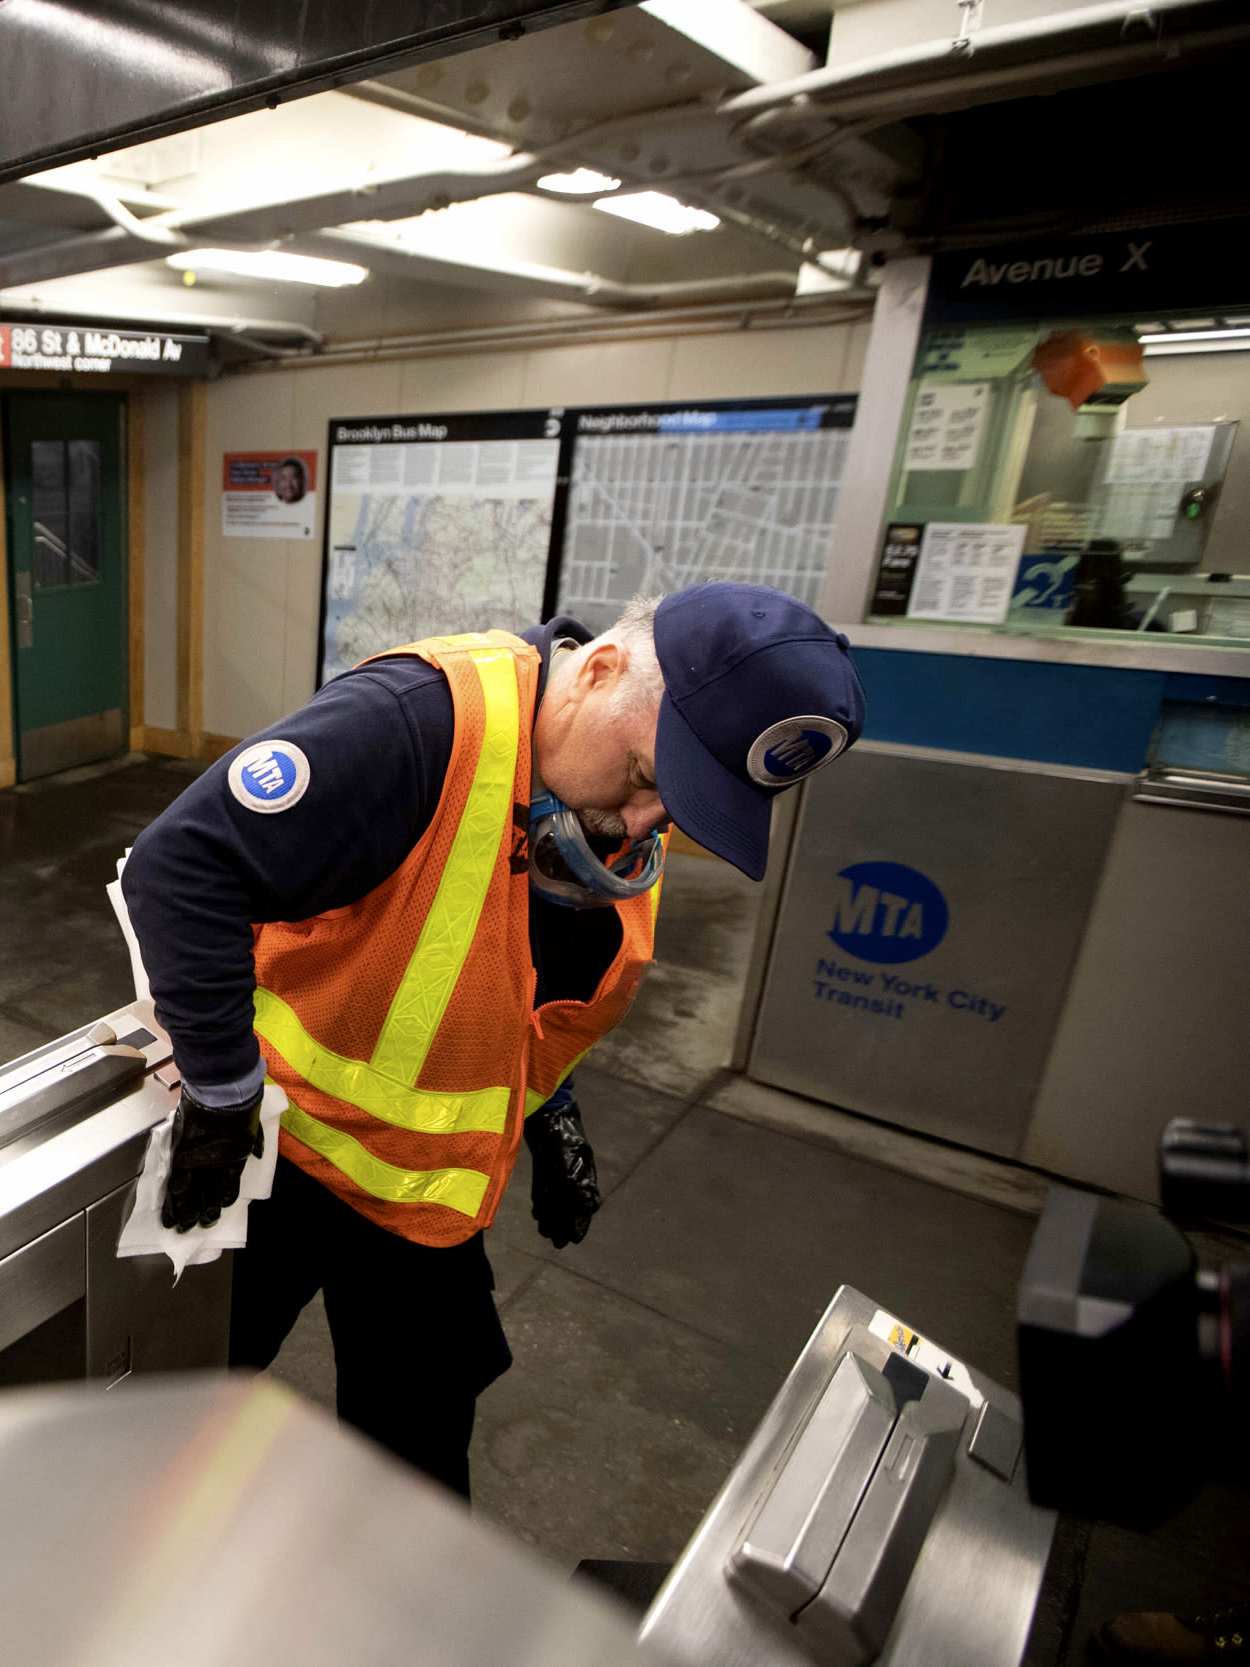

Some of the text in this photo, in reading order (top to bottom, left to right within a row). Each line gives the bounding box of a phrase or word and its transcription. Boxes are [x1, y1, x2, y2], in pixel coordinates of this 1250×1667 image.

[961, 242, 1153, 288] Avenue X
[11, 328, 38, 353] 86
[42, 330, 62, 355] St
[67, 331, 81, 355] &
[85, 331, 160, 360] McDonald
[163, 338, 182, 361] Av
[11, 352, 72, 370] Northwest
[337, 423, 447, 442] Brooklyn Bus Map
[766, 731, 816, 772] MTA
[244, 751, 286, 795] MTA
[828, 874, 925, 940] MTA
[814, 980, 905, 1019] Transit
[816, 958, 1006, 1022] New York City
